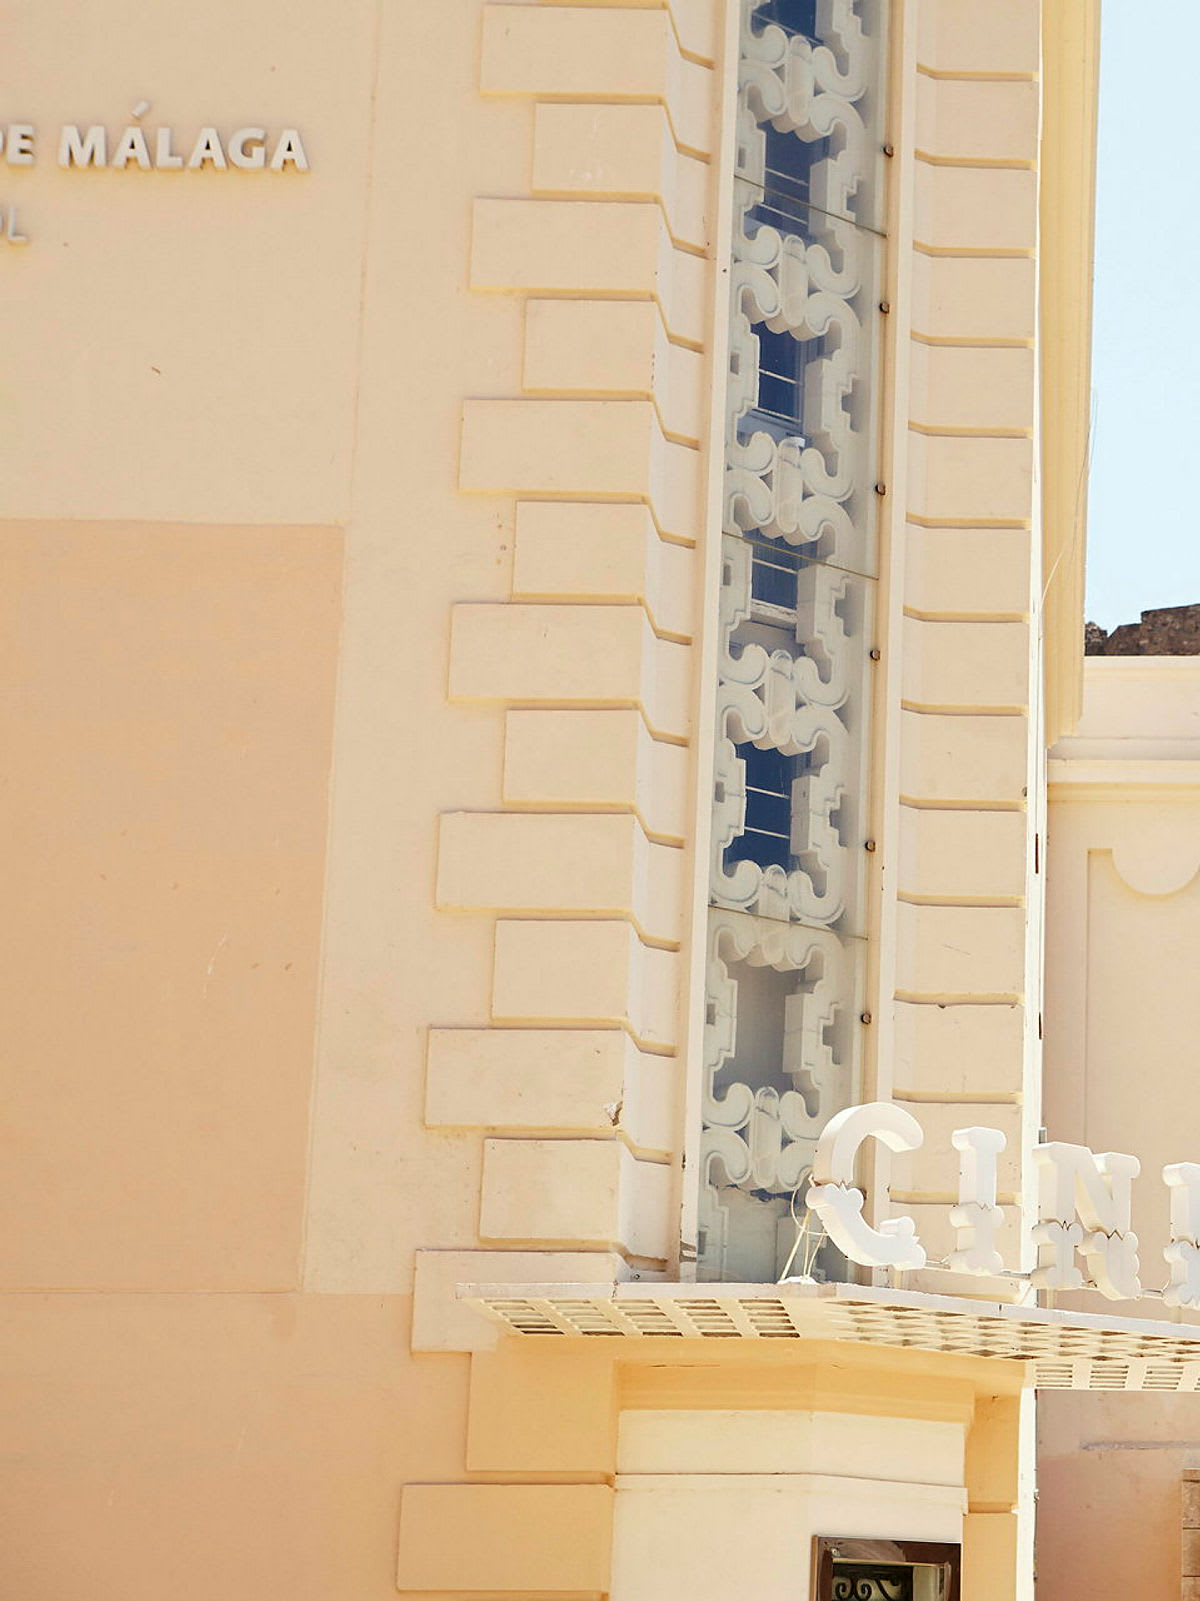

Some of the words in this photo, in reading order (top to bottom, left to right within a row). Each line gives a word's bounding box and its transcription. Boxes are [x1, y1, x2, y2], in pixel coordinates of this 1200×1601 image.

[0, 124, 35, 165] E
[57, 101, 310, 170] MÁLAGA
[0, 204, 29, 242] L
